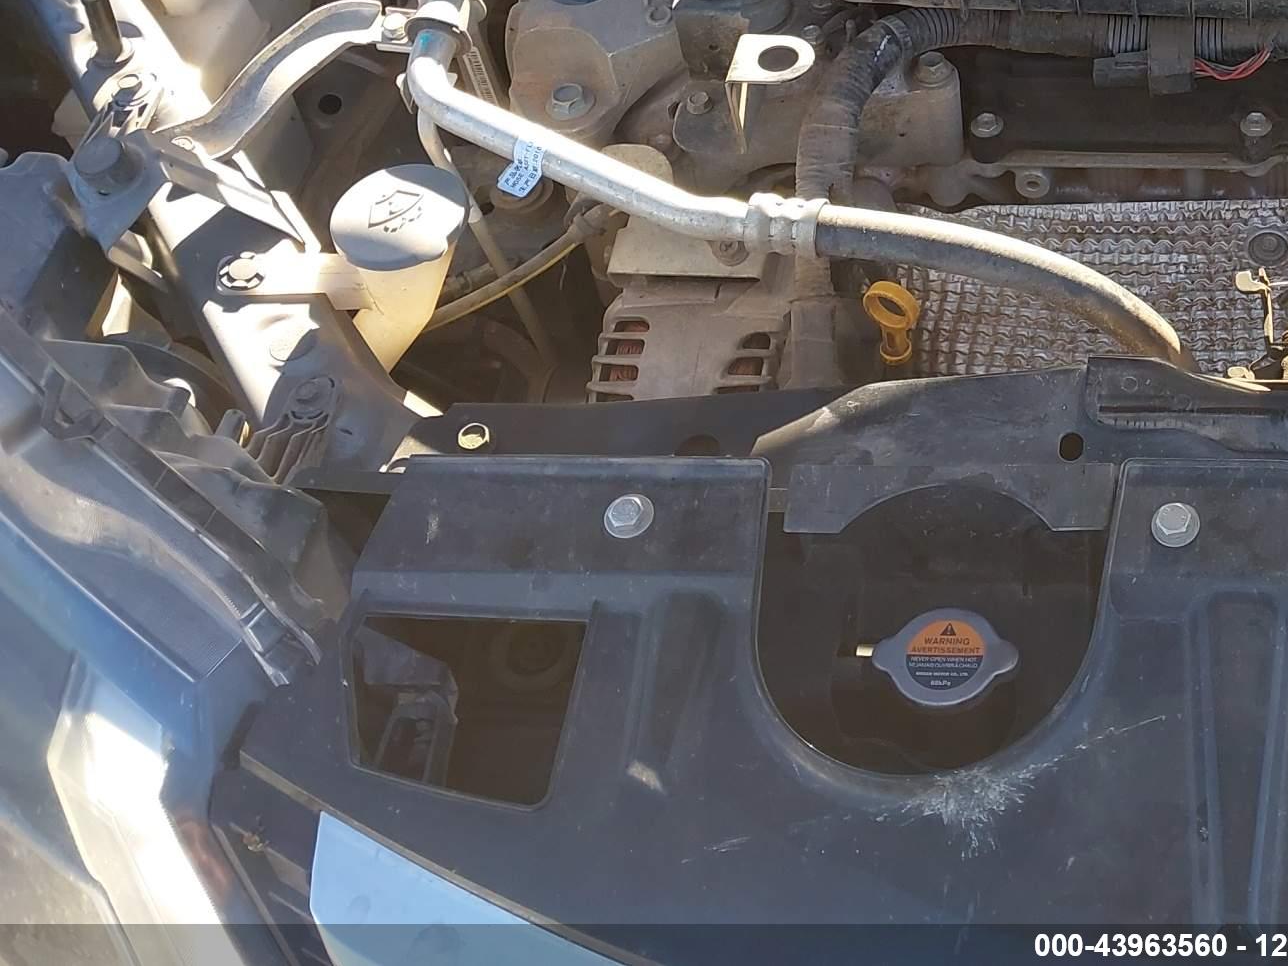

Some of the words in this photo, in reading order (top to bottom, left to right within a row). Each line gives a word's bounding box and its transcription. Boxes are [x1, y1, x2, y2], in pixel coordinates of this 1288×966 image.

[511, 173, 525, 188] HOSE
[924, 637, 970, 646] WARNING
[911, 646, 980, 654] AVERTISSEMENT
